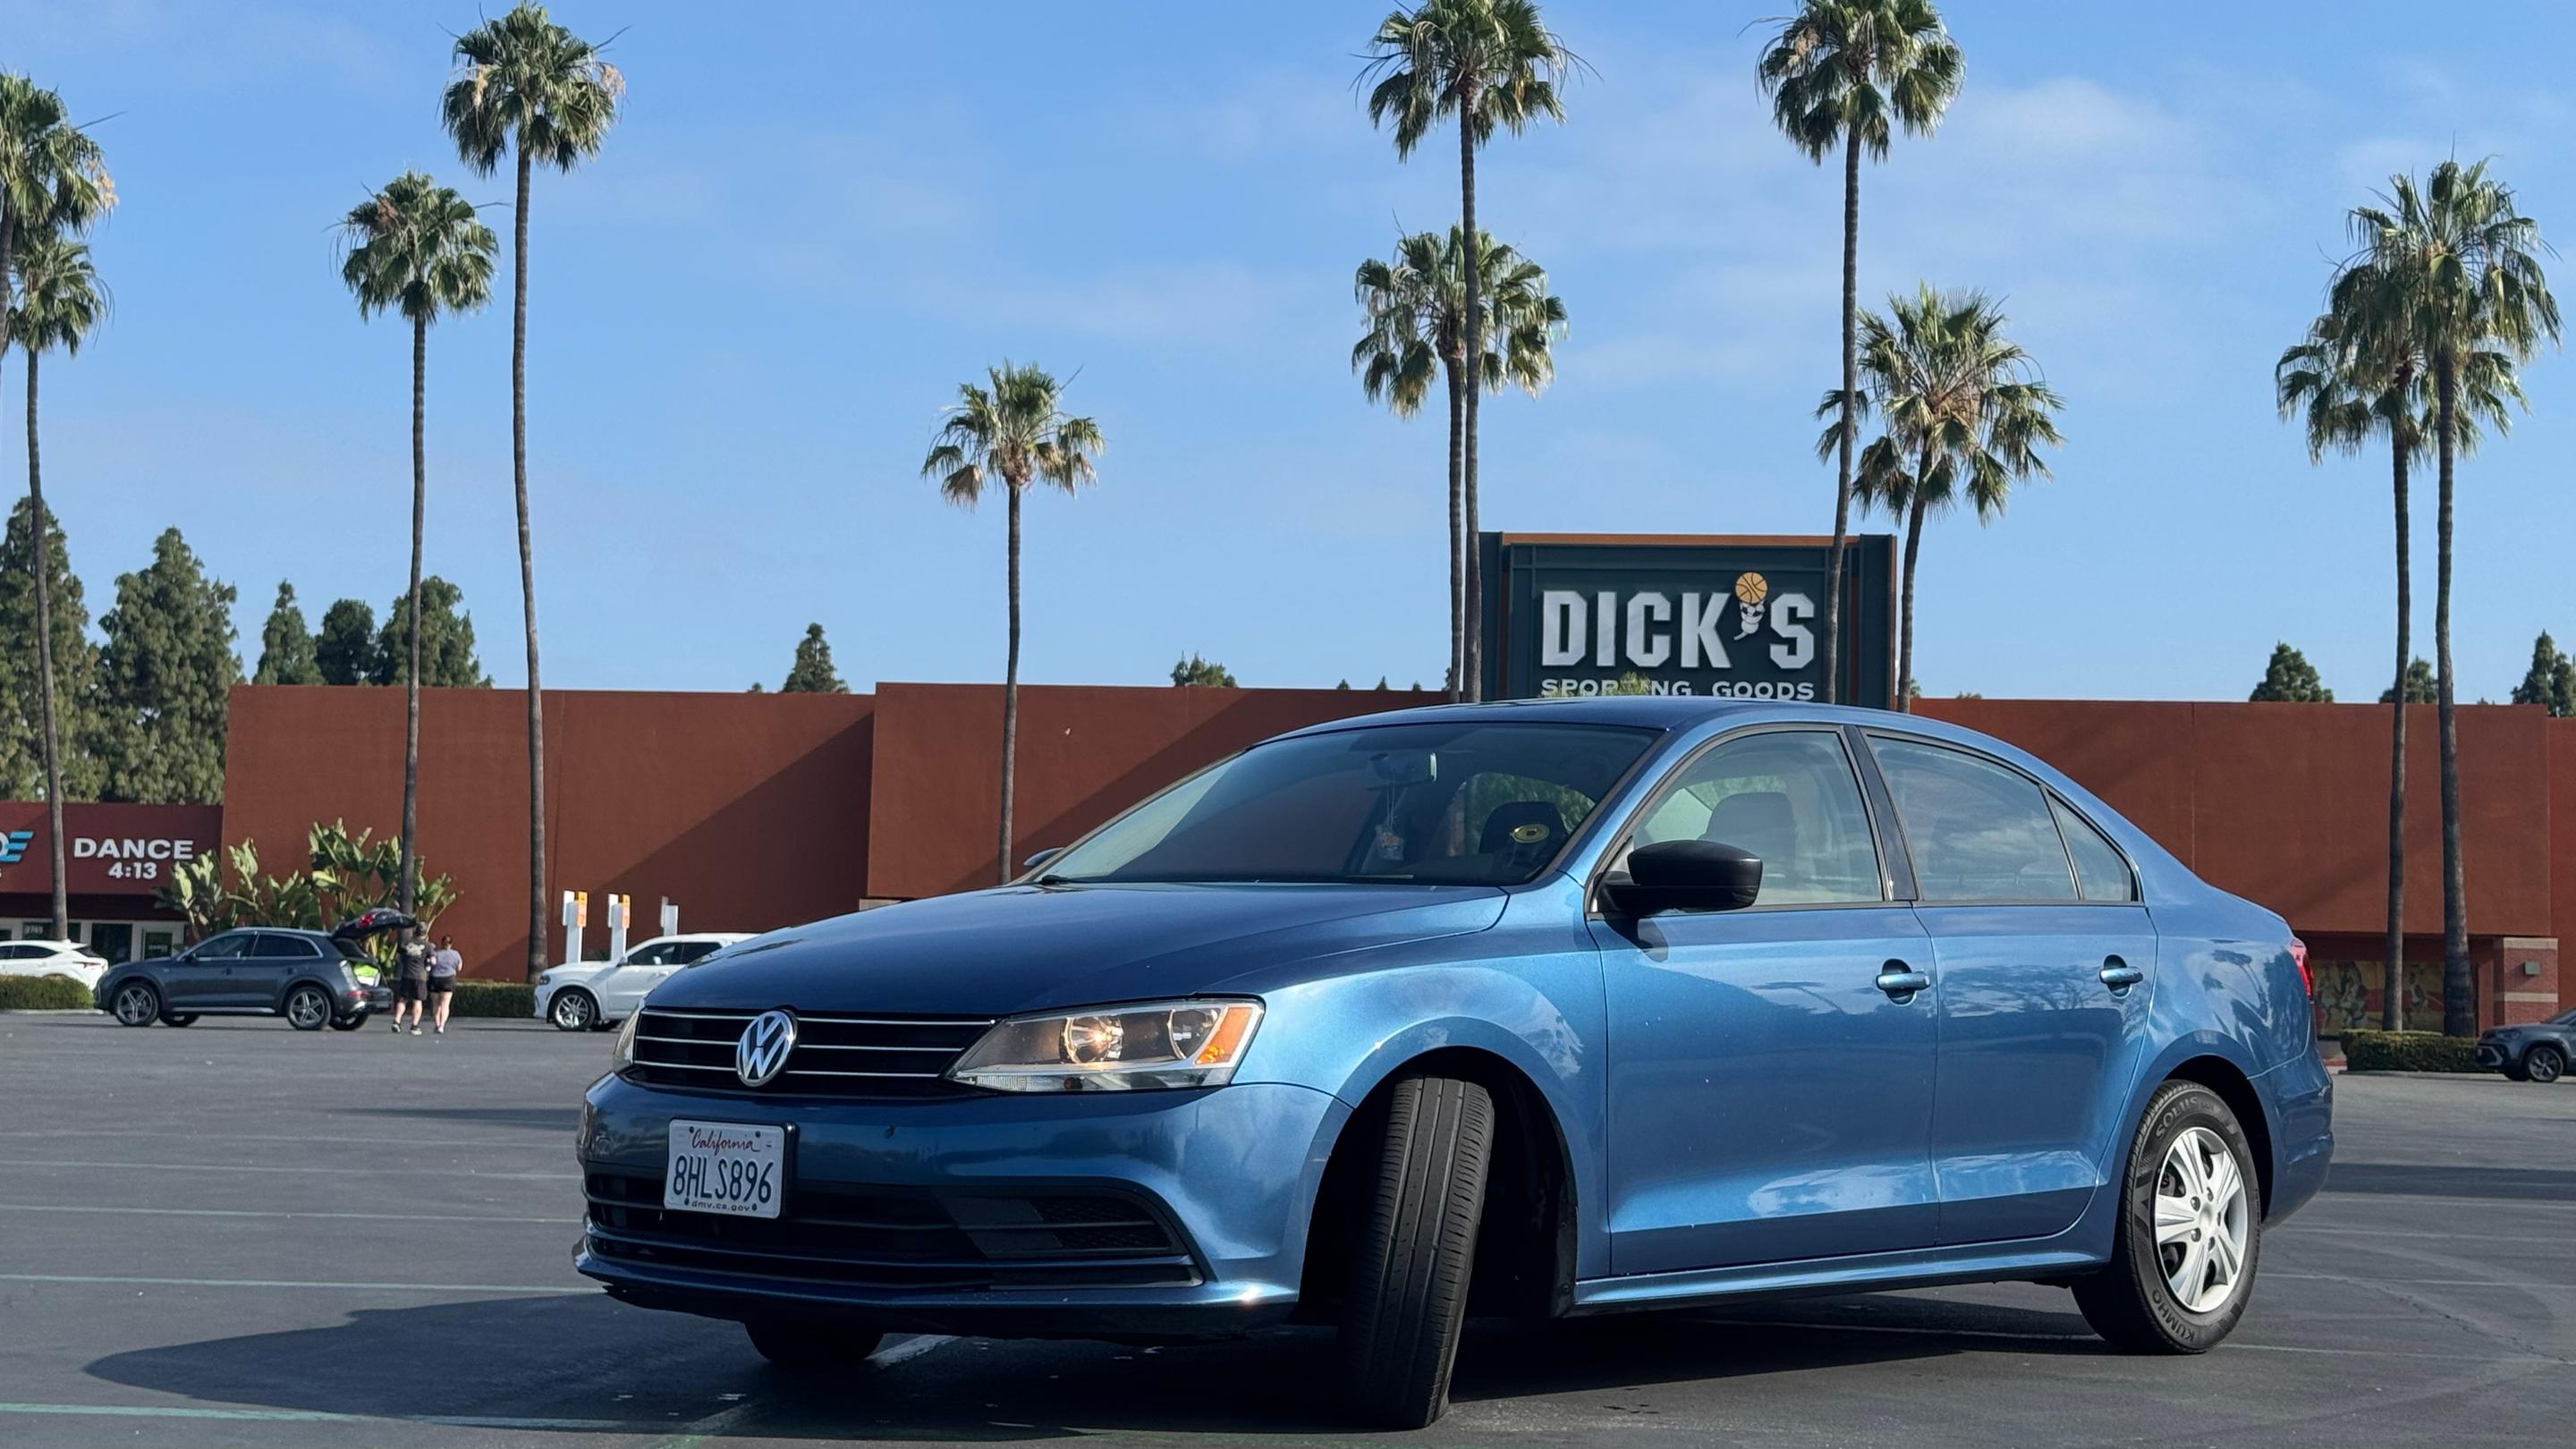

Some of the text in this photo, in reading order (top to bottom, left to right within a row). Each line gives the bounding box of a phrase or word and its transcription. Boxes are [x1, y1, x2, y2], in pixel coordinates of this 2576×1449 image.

[1542, 572, 1814, 669] DICK'S
[1541, 679, 1815, 700] SPORNG GOODS
[73, 837, 194, 860] DANCE
[108, 861, 157, 879] 4:13
[691, 1129, 761, 1157] California
[673, 1155, 774, 1203] 8HLS896
[691, 1199, 750, 1212] dmv.ca.gov
[2152, 1289, 2195, 1342] KUMHO
